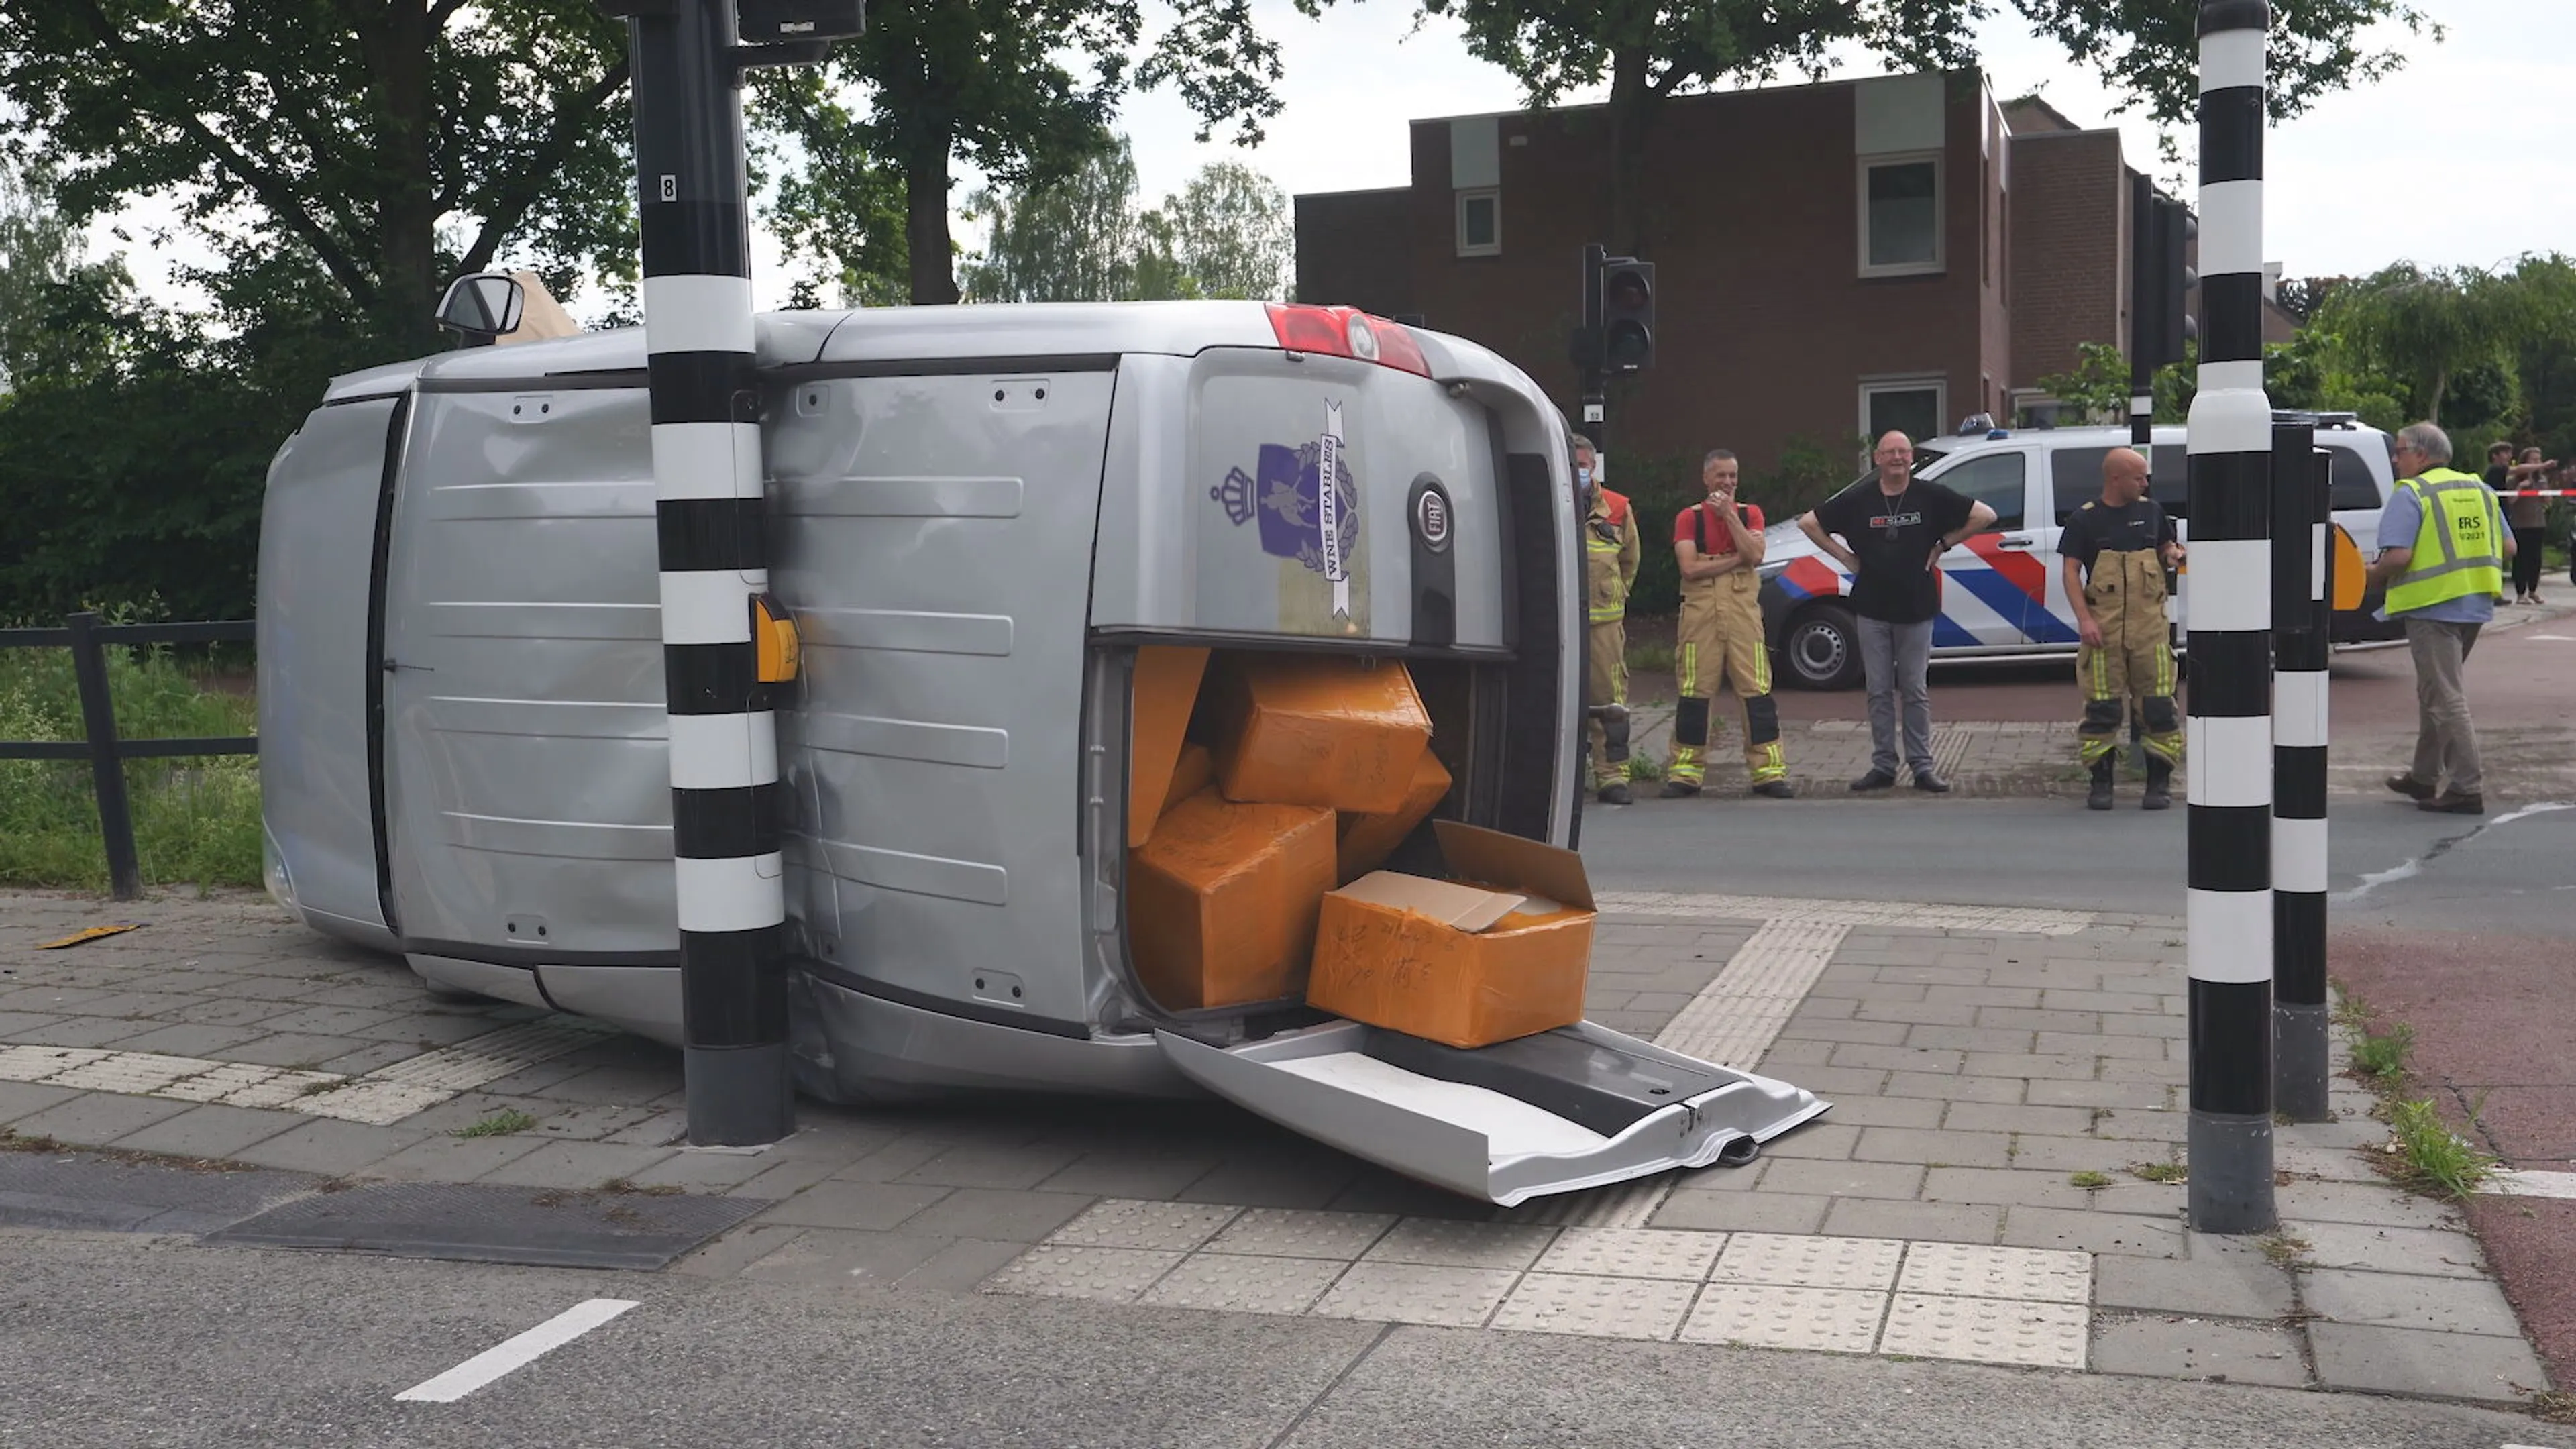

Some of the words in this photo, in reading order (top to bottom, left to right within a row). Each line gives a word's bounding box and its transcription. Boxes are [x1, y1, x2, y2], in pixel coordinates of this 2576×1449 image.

[664, 179, 674, 197] 8
[1323, 438, 1333, 525] STABLES
[1427, 500, 1442, 532] FIAT
[2459, 516, 2481, 530] ERS
